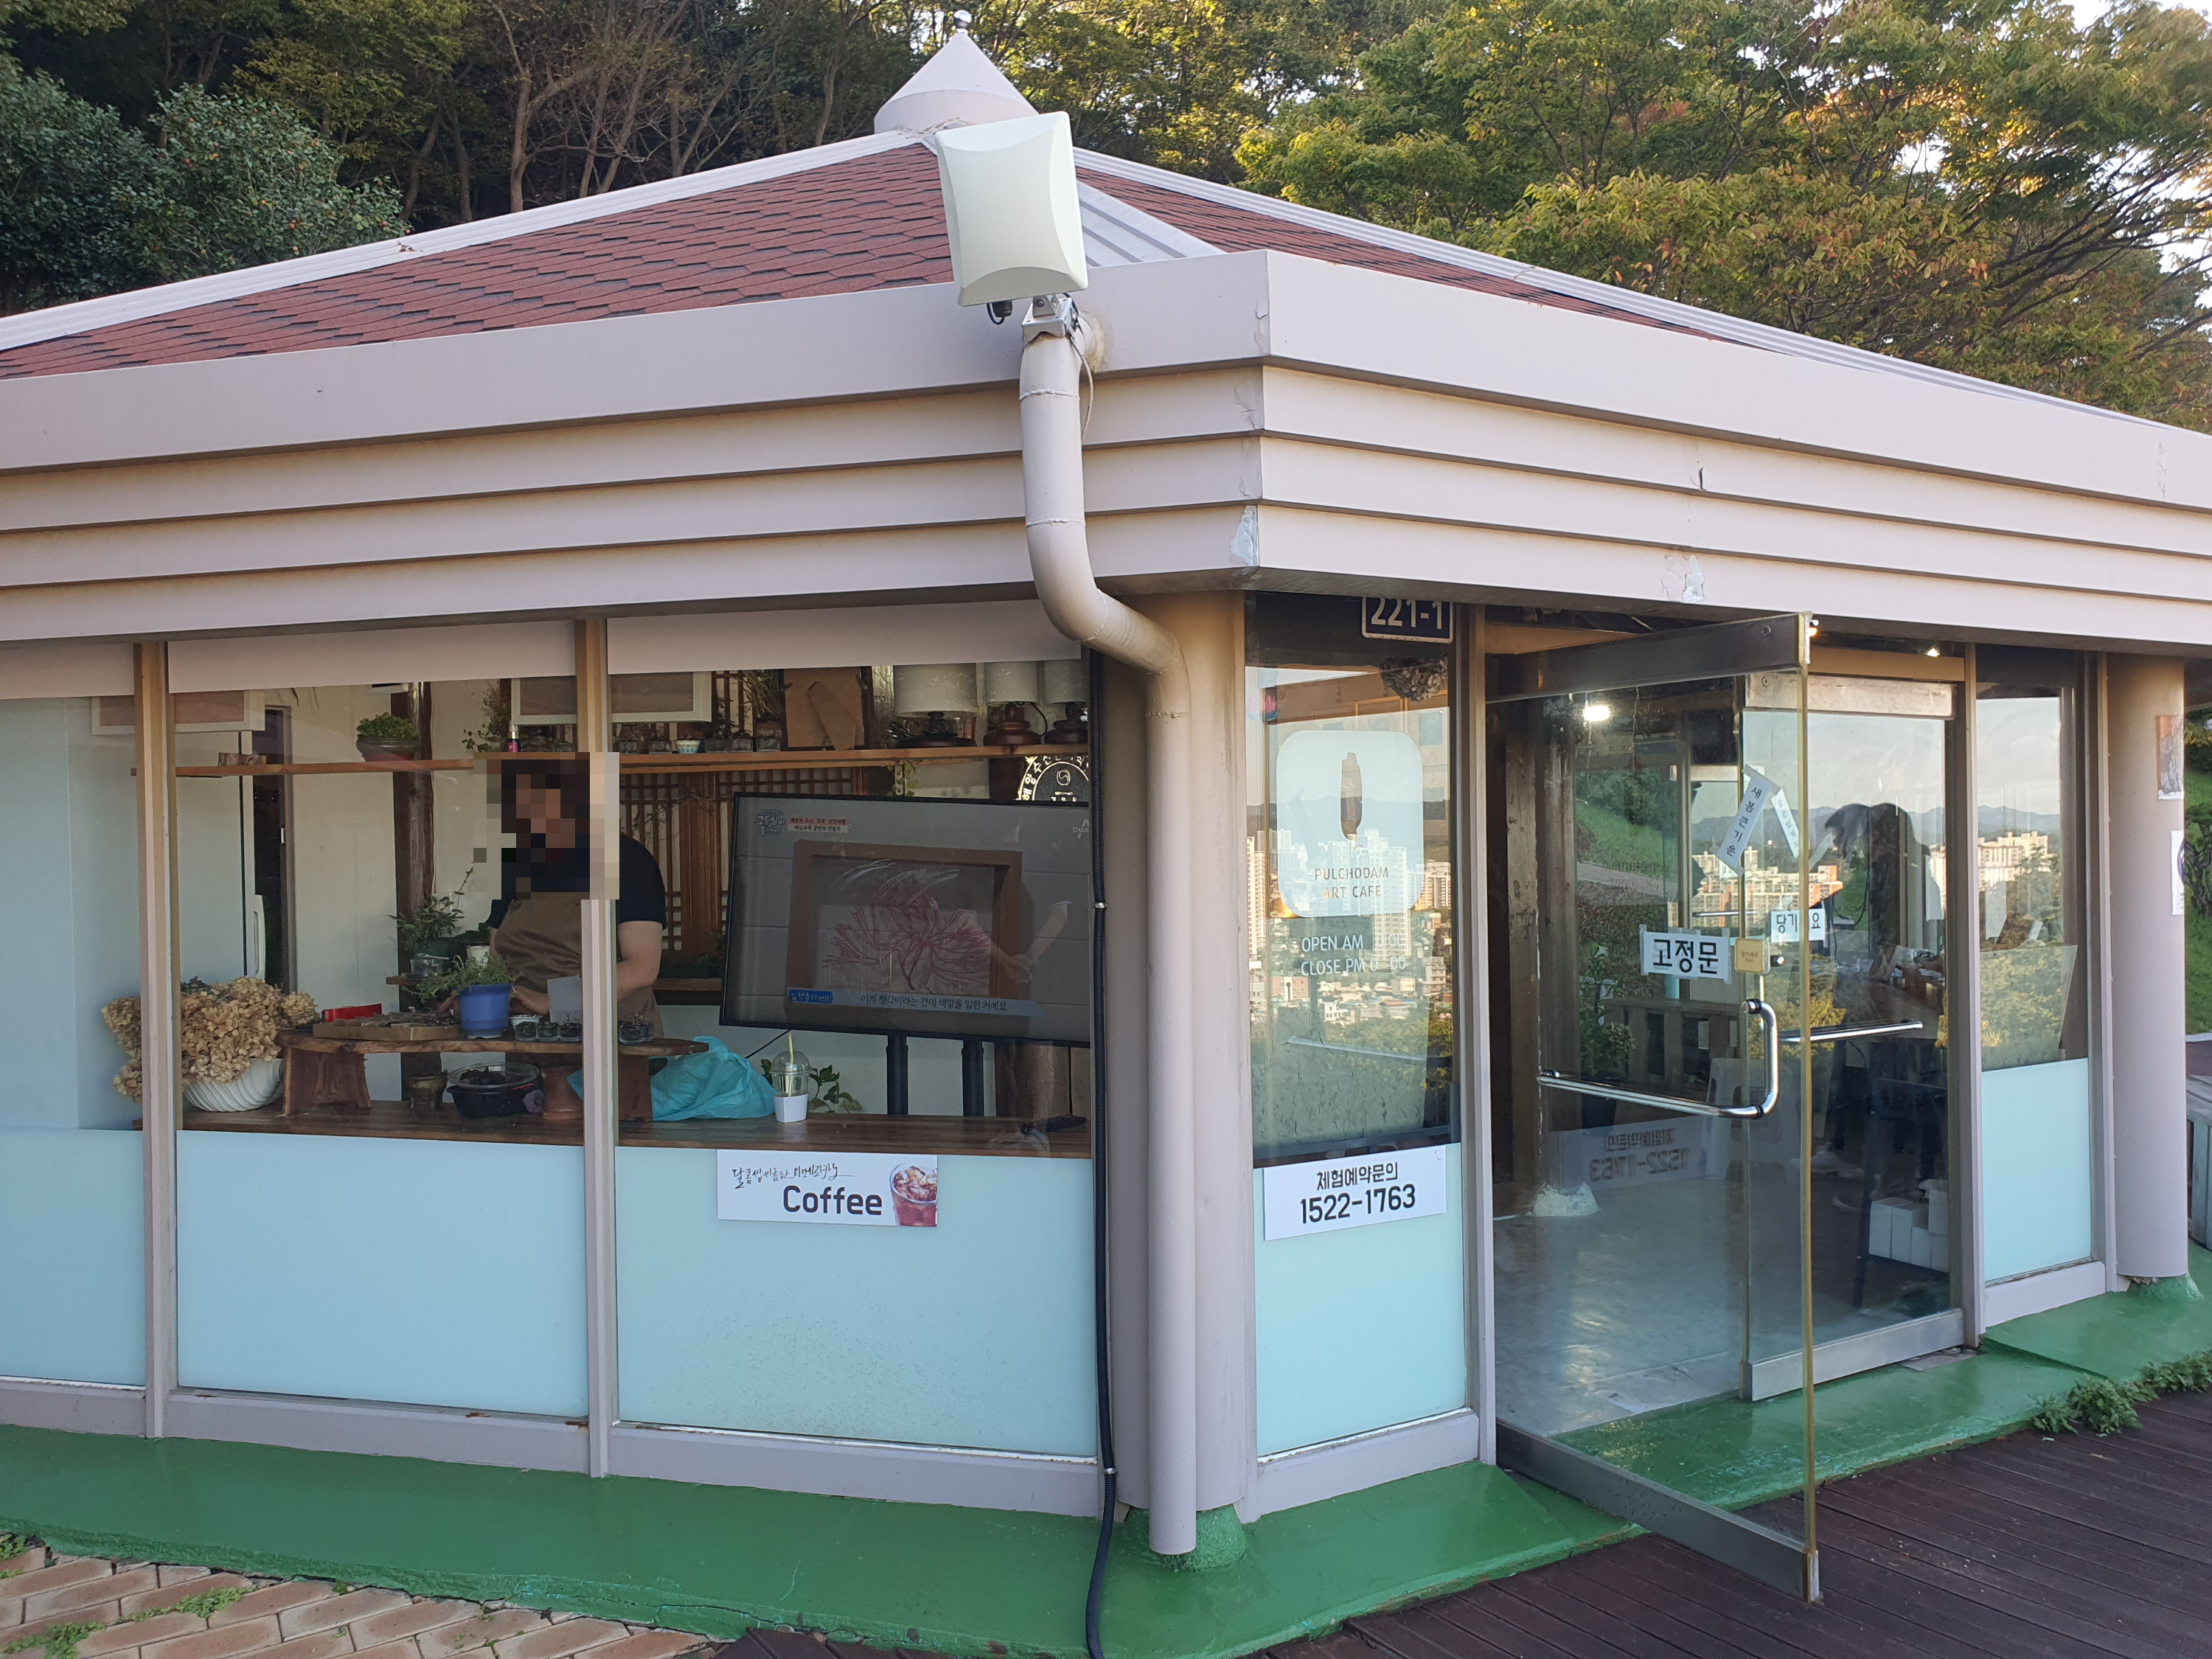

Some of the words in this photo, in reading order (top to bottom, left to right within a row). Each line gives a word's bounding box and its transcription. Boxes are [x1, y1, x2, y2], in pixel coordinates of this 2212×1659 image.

[1371, 597, 1442, 630] 221-1
[757, 815, 785, 826] 고두심이
[1726, 786, 1763, 858] 새봄큰기운
[1315, 866, 1389, 880] PULCHODAM
[1323, 886, 1346, 899] ART
[1352, 885, 1382, 898] CAFE
[1775, 912, 1821, 933] 당기요
[1301, 935, 1338, 953] OPEN
[1342, 934, 1364, 950] AM
[1652, 938, 1719, 975] 고정문
[1301, 959, 1341, 976] CLOSE
[1346, 958, 1366, 973] PM
[860, 995, 877, 1004] 이게
[878, 995, 919, 1006] 청각이라는
[920, 997, 936, 1007] 건데
[938, 998, 962, 1009] 색깔을
[964, 999, 981, 1009] 입힌
[982, 1001, 1007, 1012] 거예요
[793, 1162, 855, 1181] 아메리카노
[1316, 1161, 1398, 1191] 체험예약문의
[783, 1185, 883, 1216] Coffee
[1300, 1183, 1416, 1224] 1522-1763
